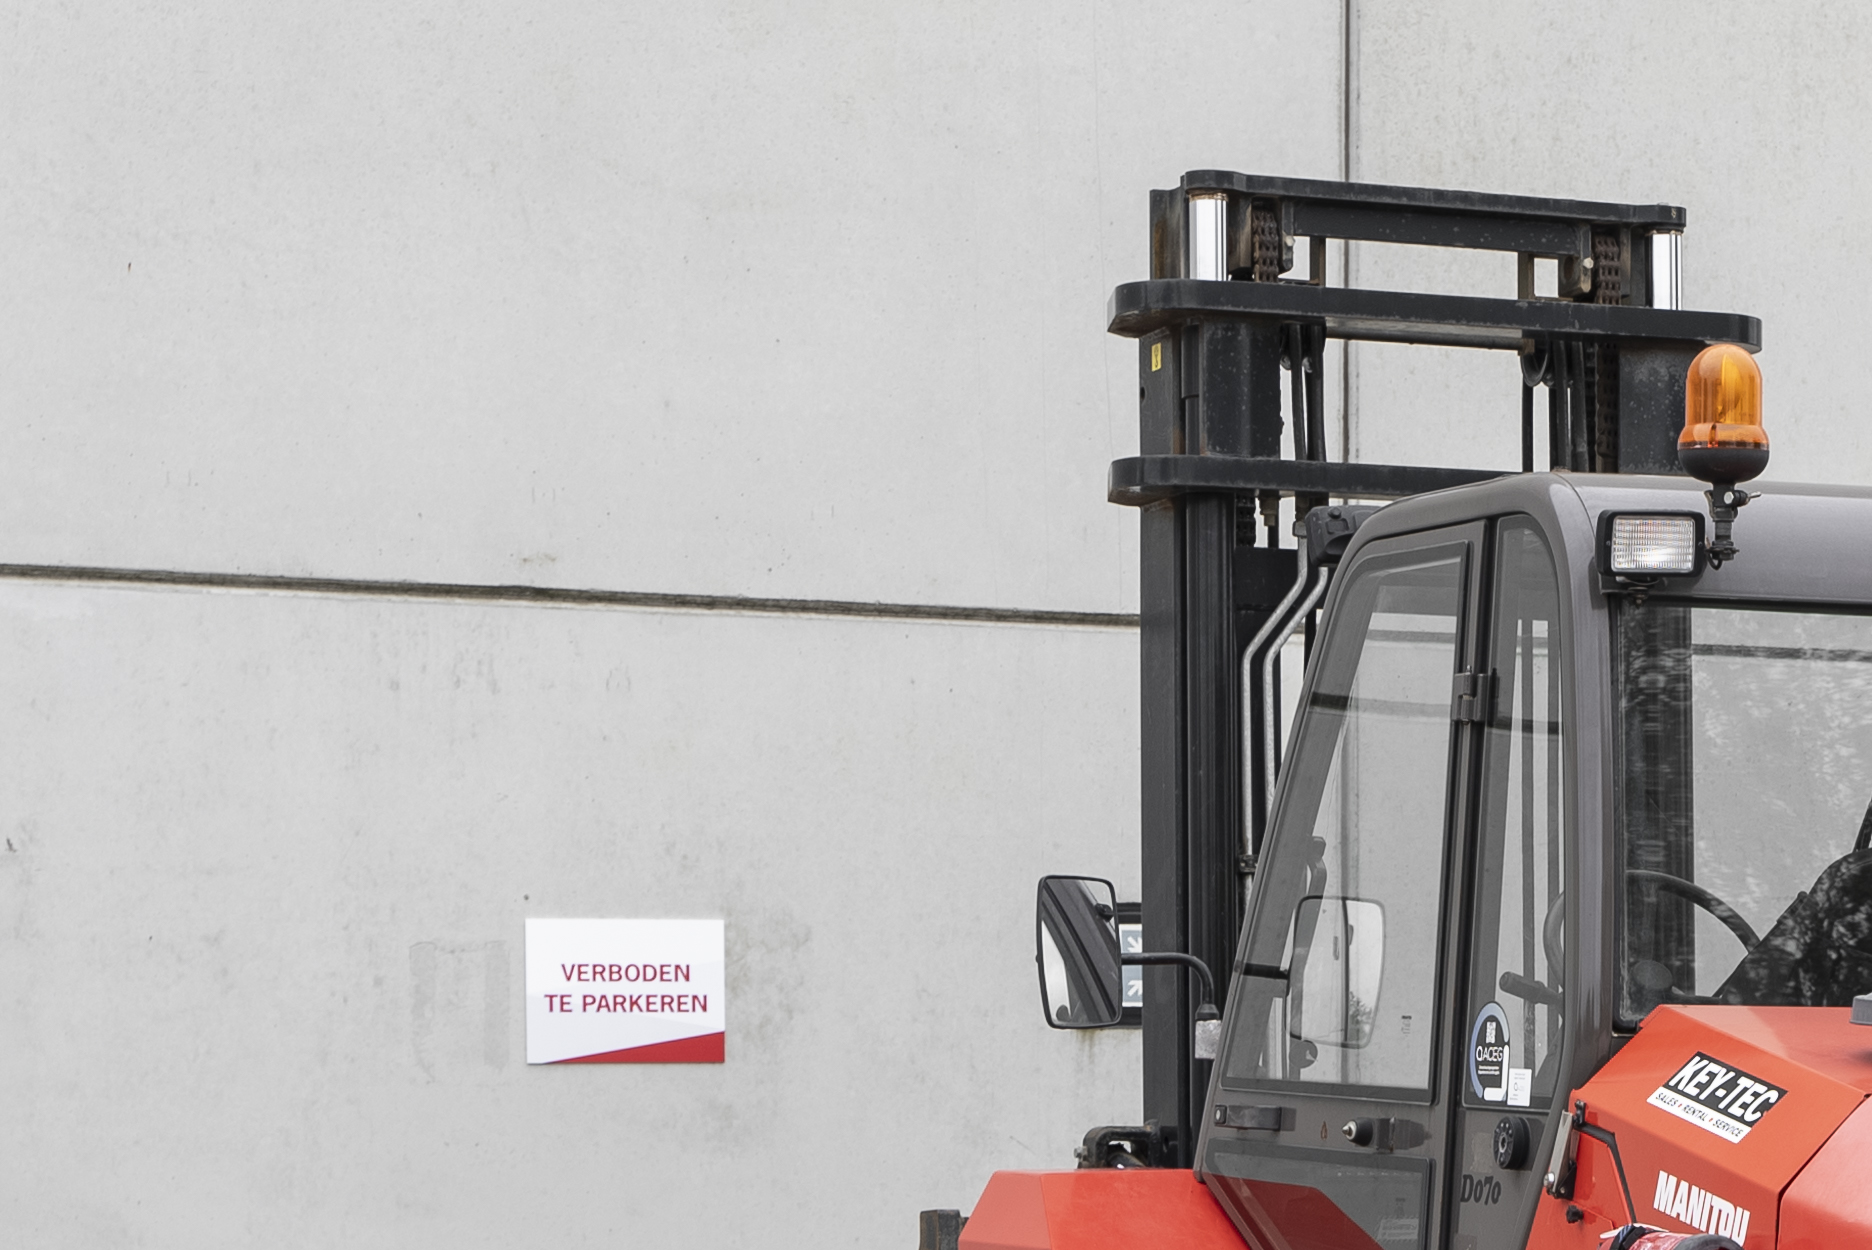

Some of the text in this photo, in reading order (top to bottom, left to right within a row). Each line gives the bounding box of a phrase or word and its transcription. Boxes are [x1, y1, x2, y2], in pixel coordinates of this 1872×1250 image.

[561, 963, 691, 982] VERBODEN
[544, 994, 708, 1013] TE PARKEREN
[1668, 1055, 1779, 1122] KEY-TEC
[1655, 1092, 1744, 1138] SALES RENTAL SERVICE
[1653, 1170, 1751, 1248] MANITOU
